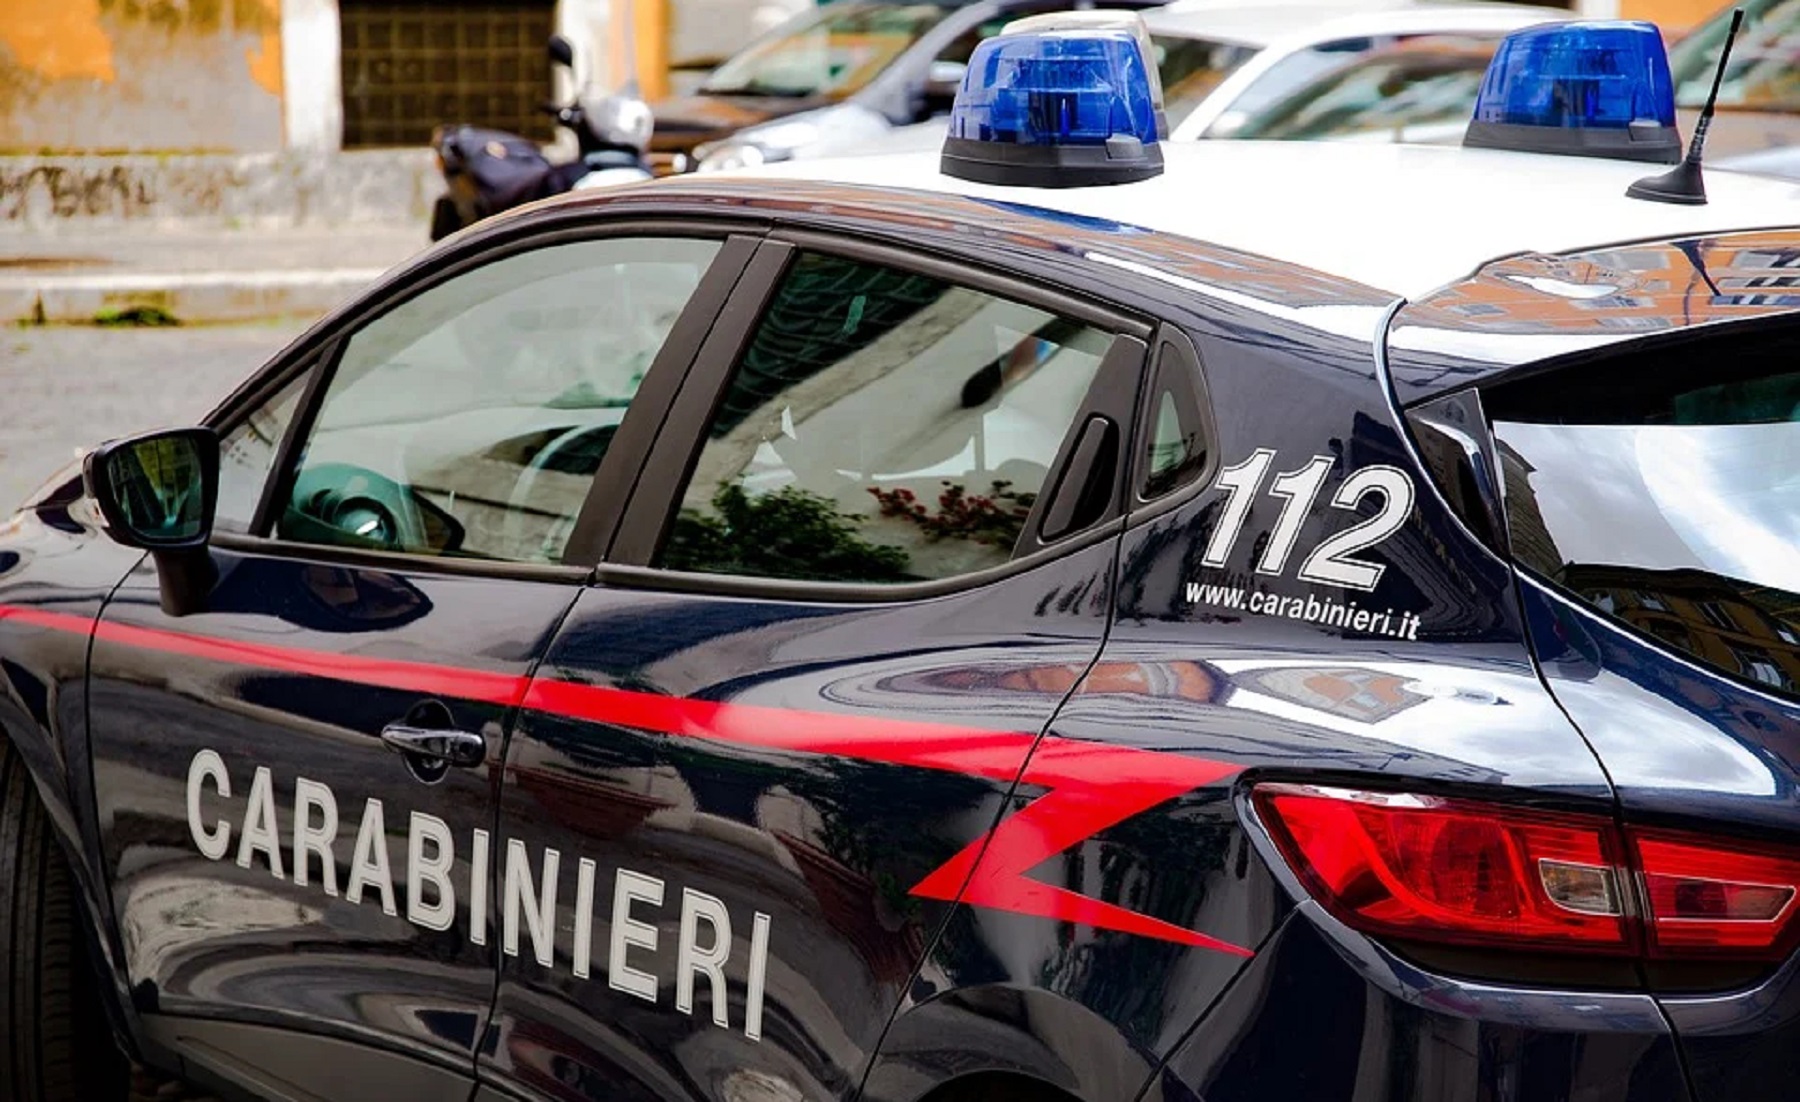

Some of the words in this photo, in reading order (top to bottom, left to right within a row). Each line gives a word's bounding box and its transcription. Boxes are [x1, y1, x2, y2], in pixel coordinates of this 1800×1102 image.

[1201, 447, 1415, 593] 112
[1186, 582, 1421, 641] www.carabinieri.it
[186, 748, 771, 1043] CARABINIERI
